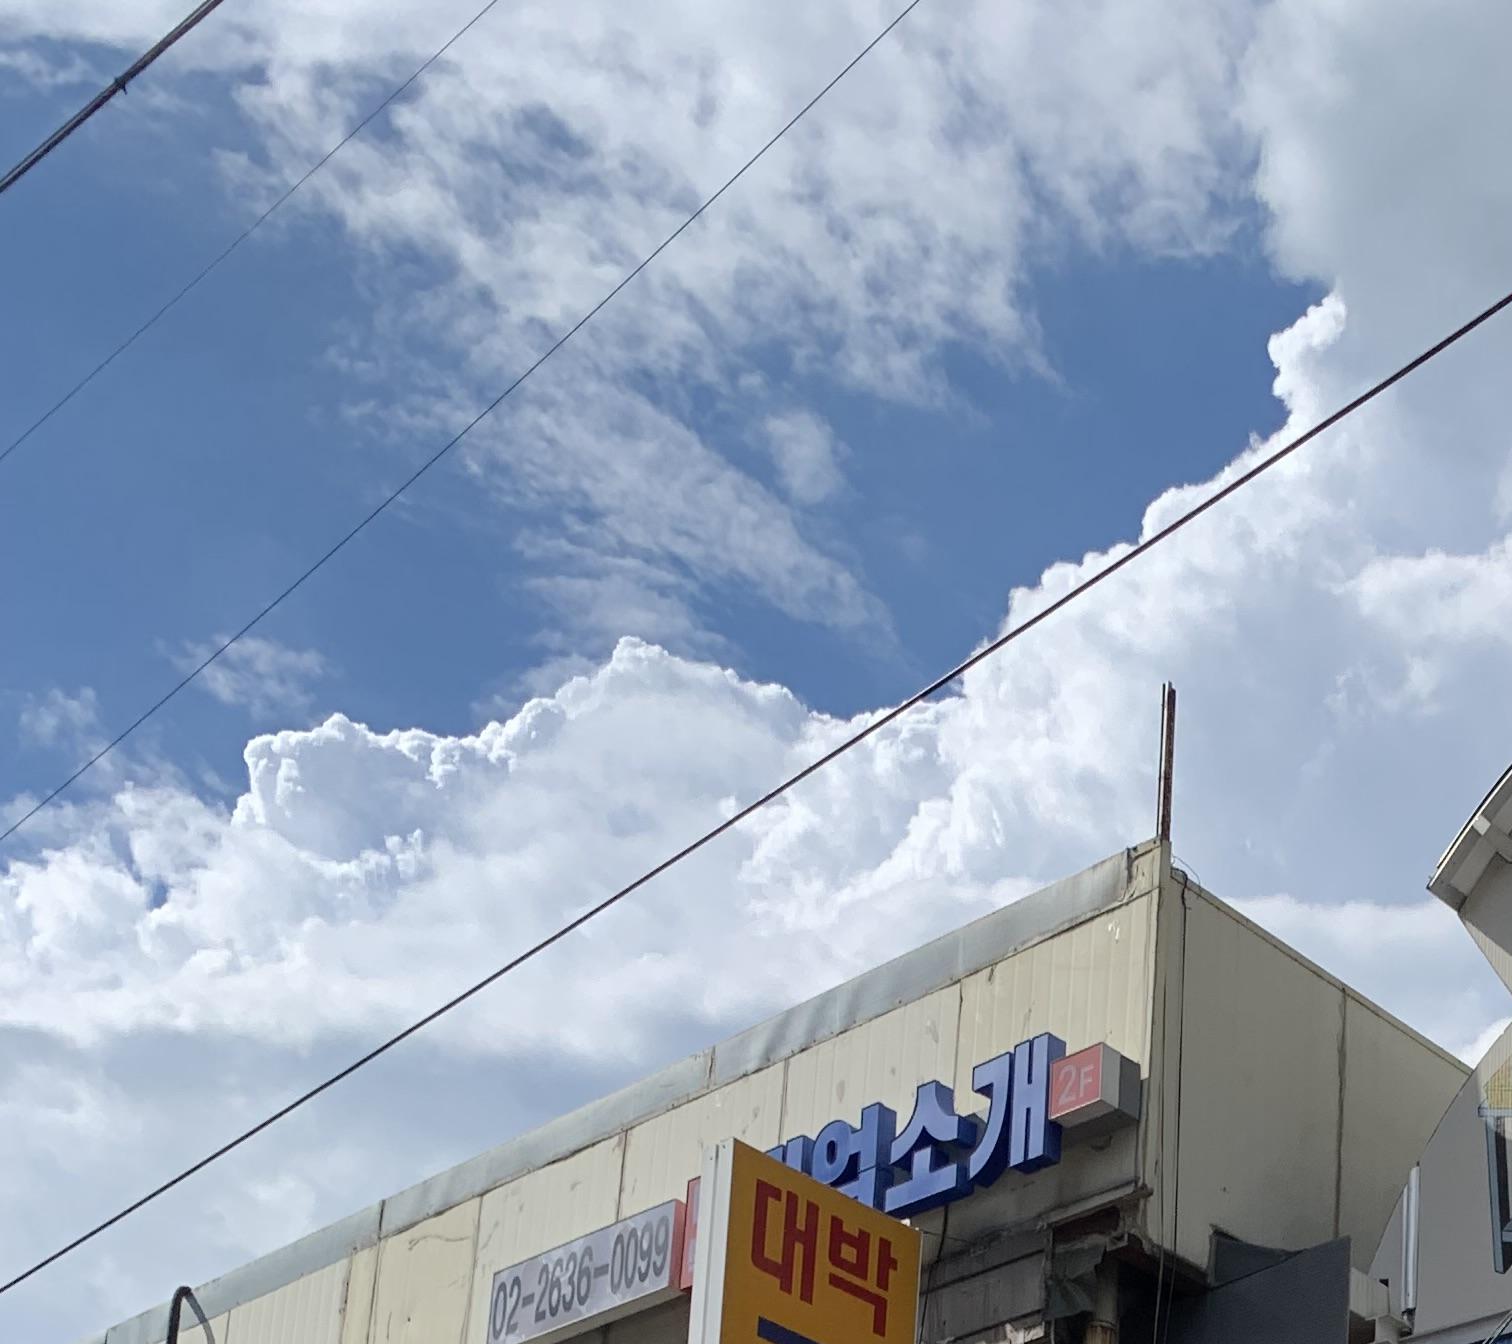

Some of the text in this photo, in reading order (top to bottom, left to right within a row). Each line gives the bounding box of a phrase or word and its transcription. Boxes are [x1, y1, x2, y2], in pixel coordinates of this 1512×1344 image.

[768, 1033, 1058, 1214] 업소개
[1058, 1063, 1095, 1104] 2F
[490, 1216, 669, 1341] 02-2636-0099
[751, 1178, 898, 1338] 대박
